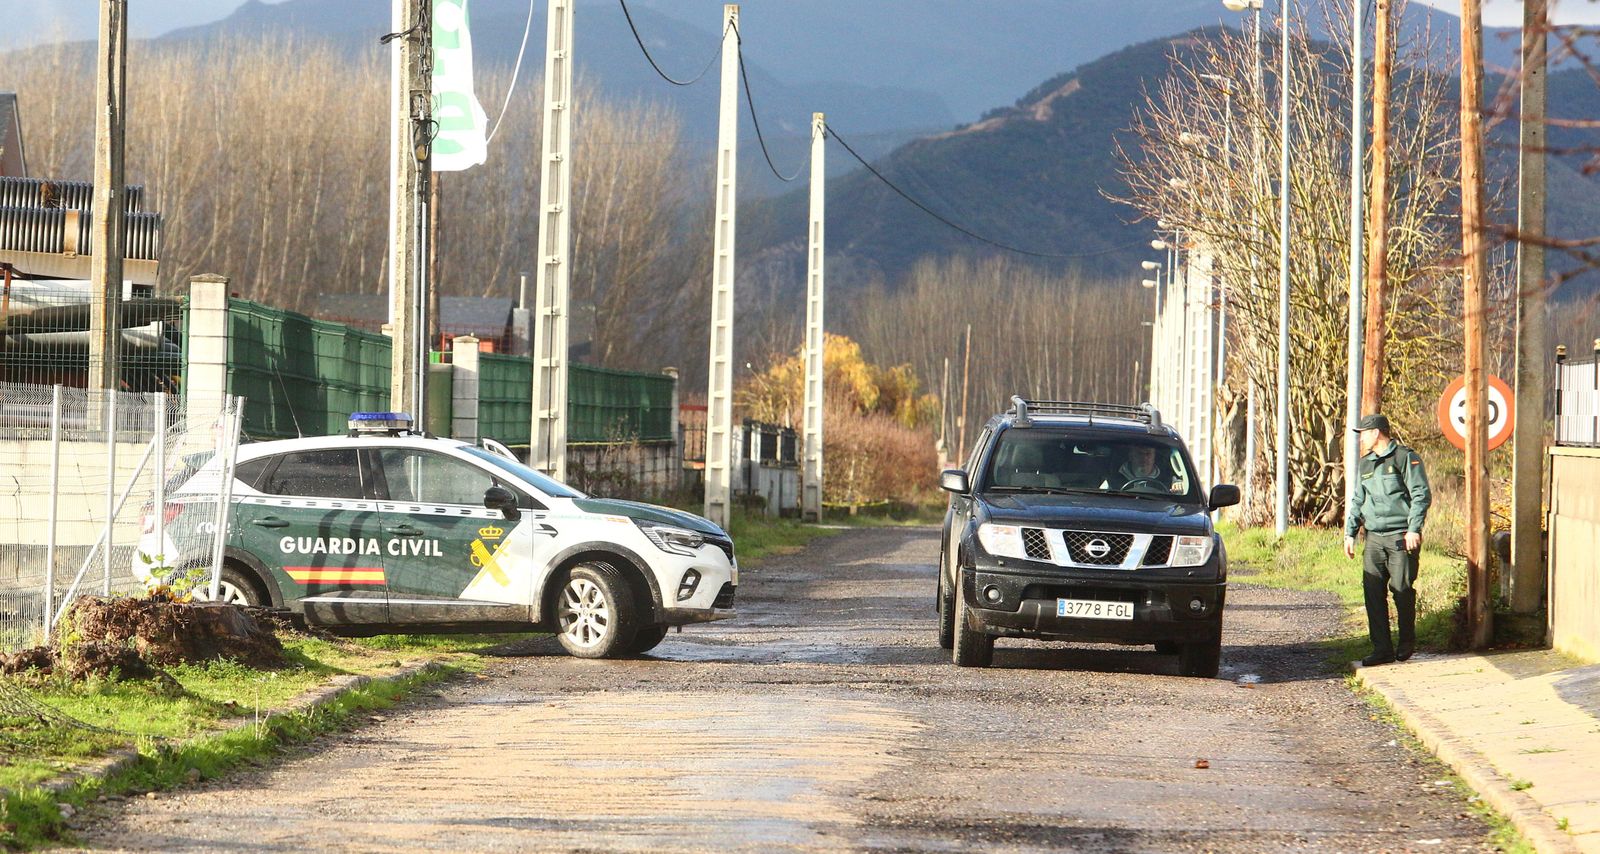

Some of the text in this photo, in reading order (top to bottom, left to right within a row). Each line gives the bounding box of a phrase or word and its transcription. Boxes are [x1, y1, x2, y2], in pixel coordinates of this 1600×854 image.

[279, 536, 443, 557] GUARDIA CIVIL
[1066, 602, 1102, 616] 3778
[1107, 604, 1132, 618] FGL
